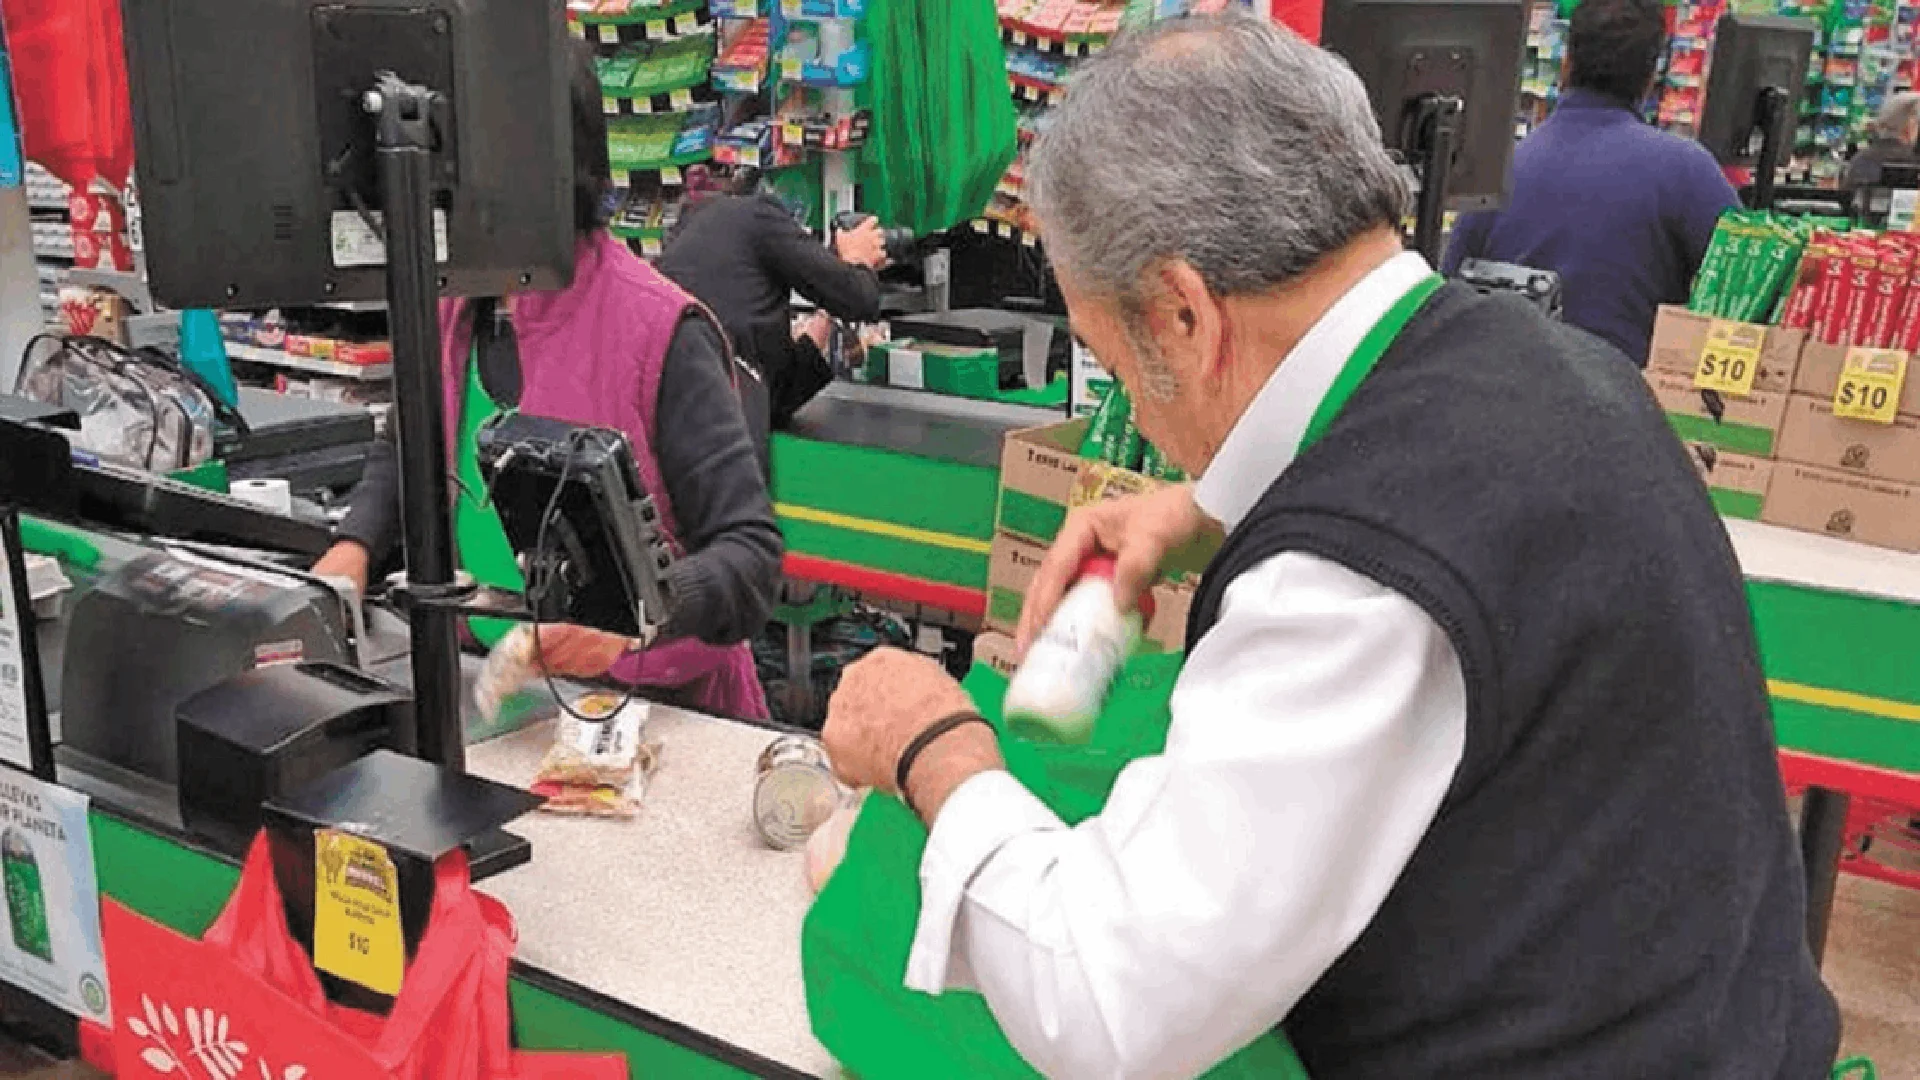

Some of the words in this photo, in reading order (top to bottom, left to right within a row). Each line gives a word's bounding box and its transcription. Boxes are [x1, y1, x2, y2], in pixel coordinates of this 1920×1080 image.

[1701, 353, 1746, 381] $10
[1839, 381, 1888, 410] $10
[349, 932, 370, 955] $10
